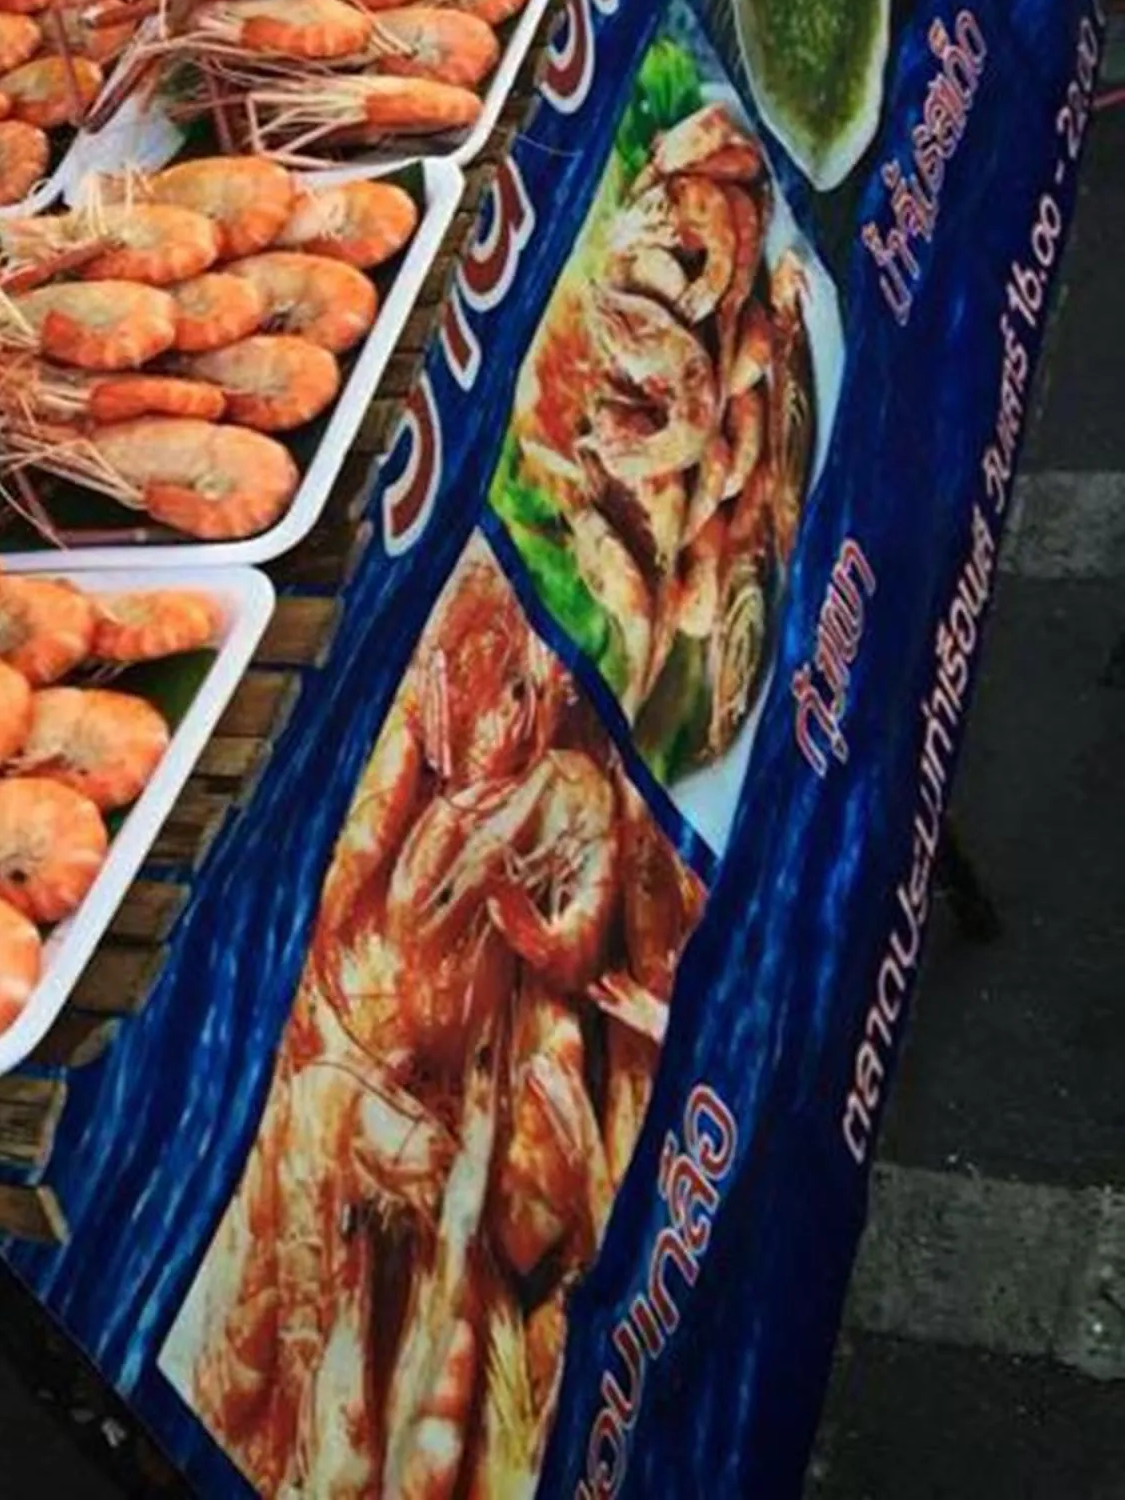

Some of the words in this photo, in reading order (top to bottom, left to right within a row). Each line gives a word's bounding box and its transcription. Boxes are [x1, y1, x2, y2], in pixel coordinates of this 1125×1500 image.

[1005, 195, 1062, 328] 16.00
[790, 537, 877, 779] กุ้งเผา
[575, 1084, 737, 1500] อบเกลือ
